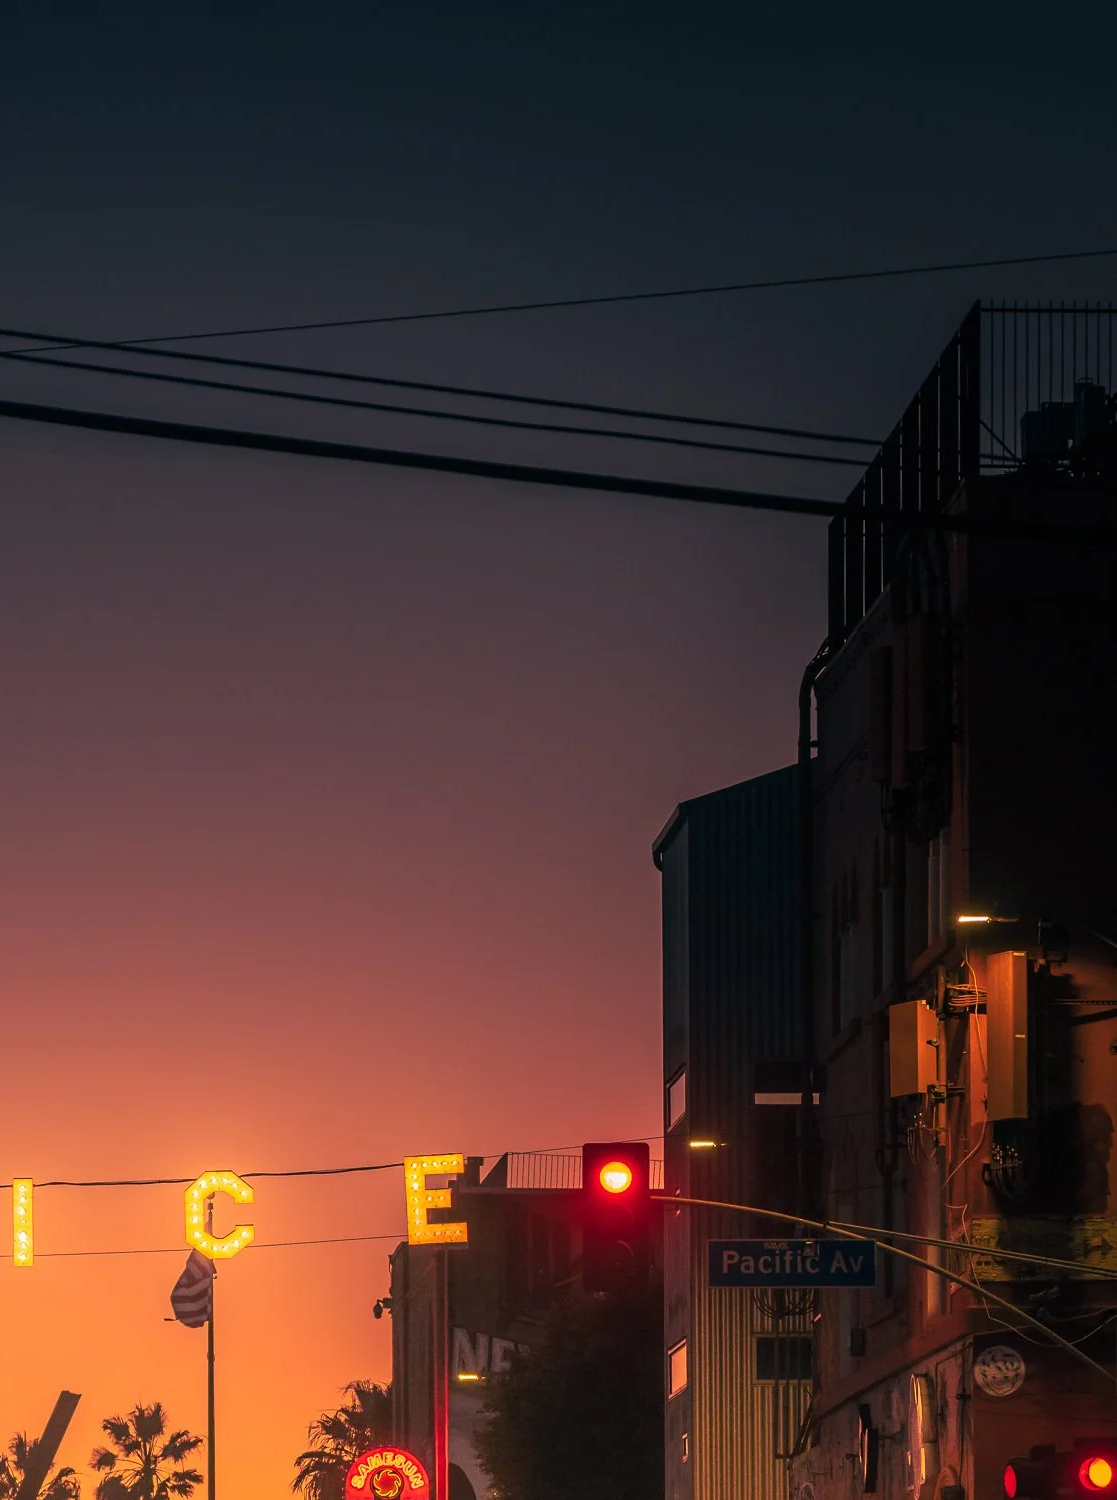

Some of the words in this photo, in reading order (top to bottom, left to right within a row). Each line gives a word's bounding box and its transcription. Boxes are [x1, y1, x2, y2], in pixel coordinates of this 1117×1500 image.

[722, 1250, 820, 1274] Pacific
[830, 1251, 864, 1274] Av
[351, 1452, 424, 1489] SAMESUN
